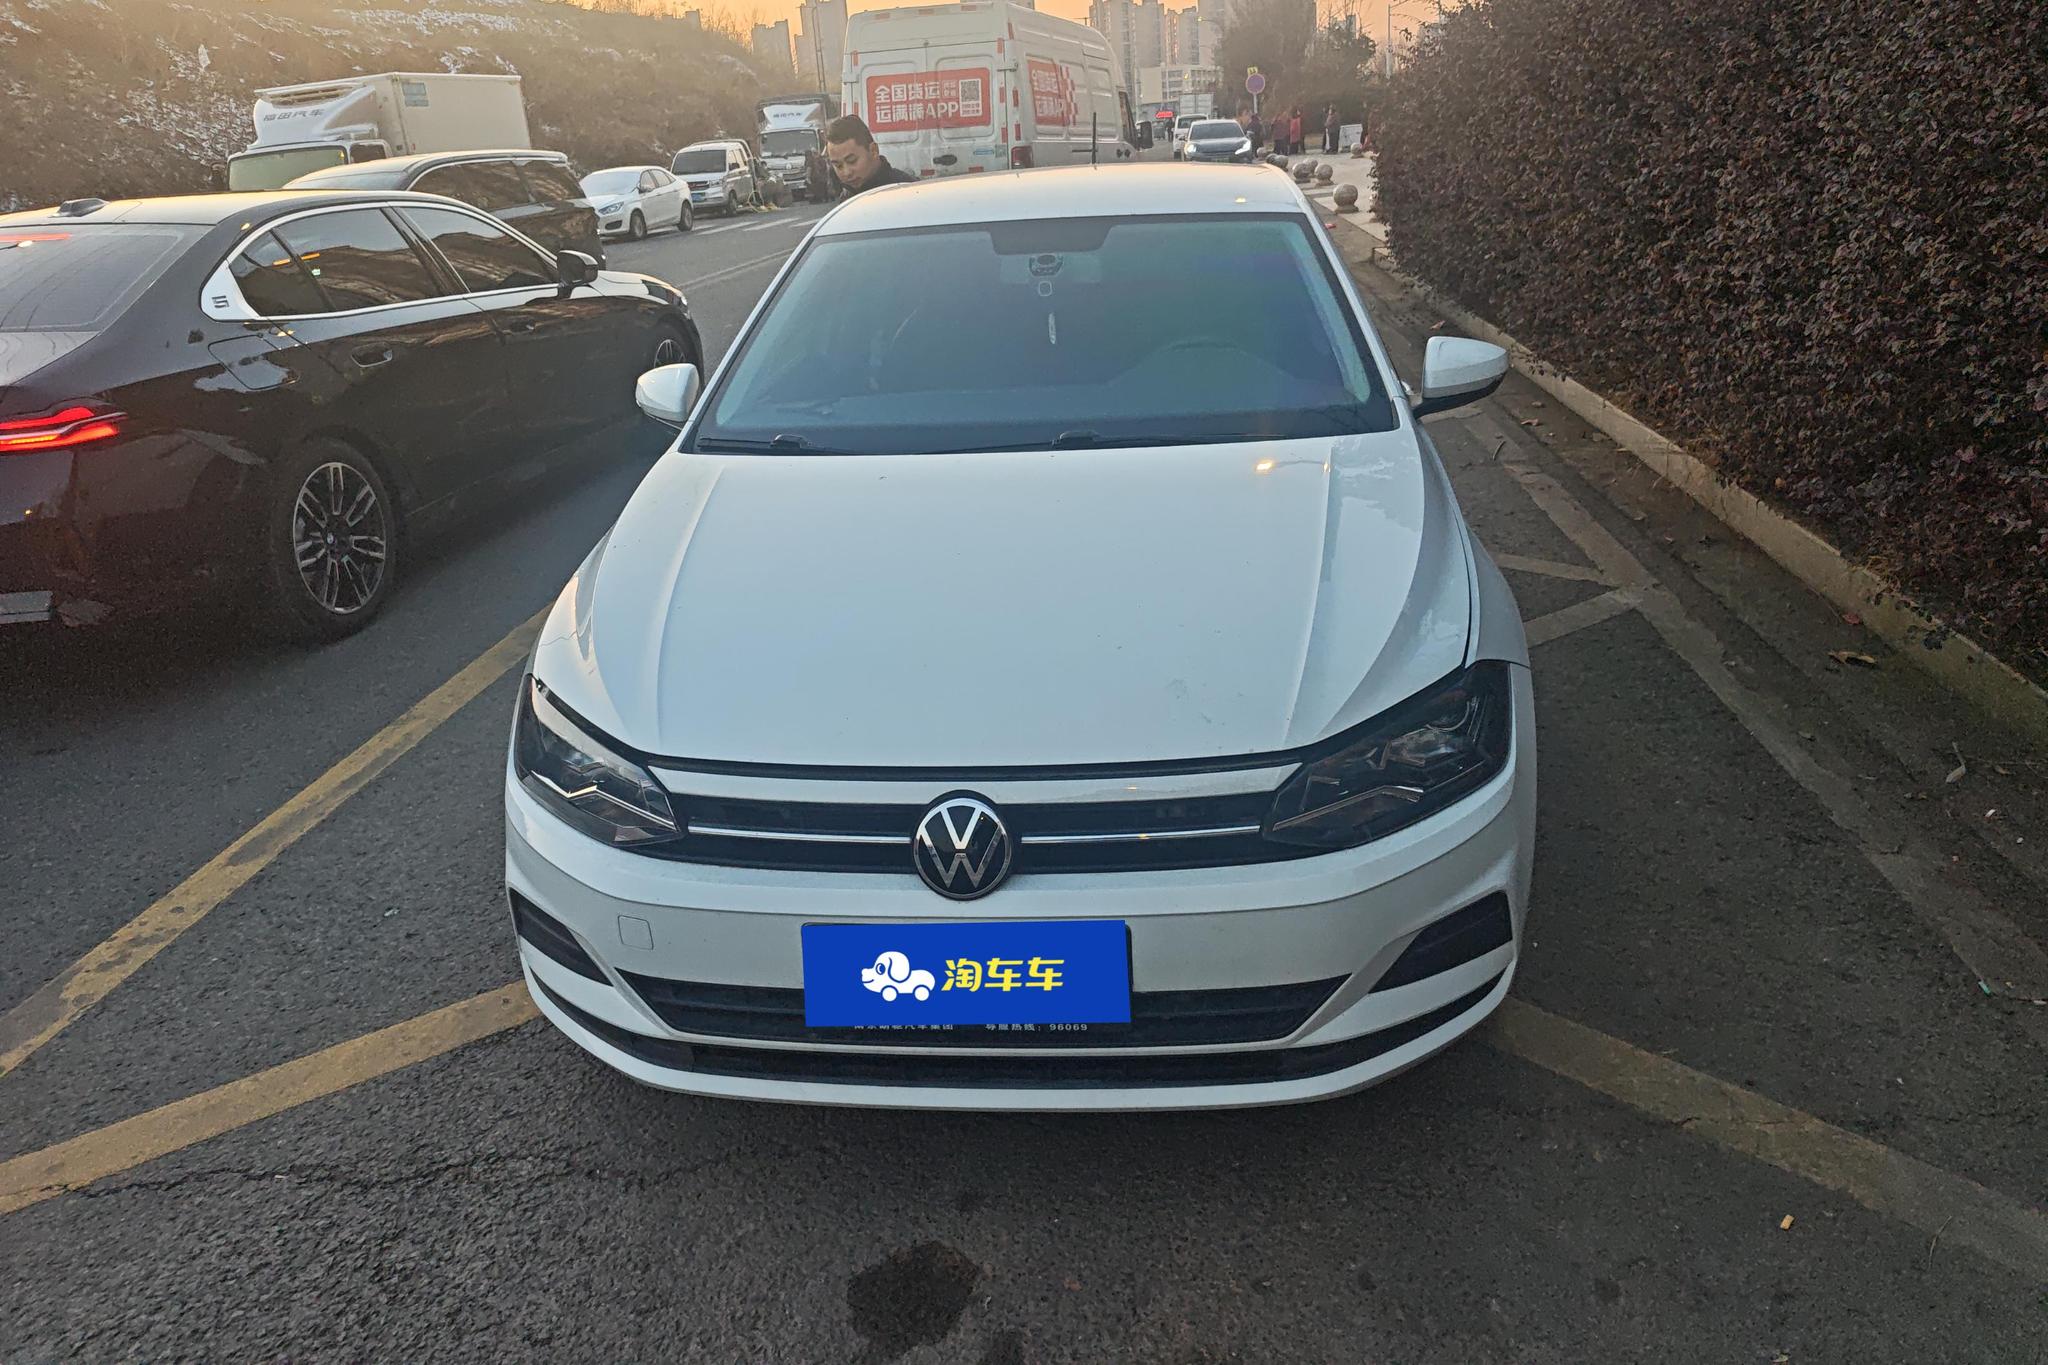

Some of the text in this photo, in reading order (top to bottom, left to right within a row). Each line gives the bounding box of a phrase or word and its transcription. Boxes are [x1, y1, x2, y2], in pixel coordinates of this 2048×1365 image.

[875, 81, 940, 103] 全国货运
[876, 102, 959, 123] 运满满APP
